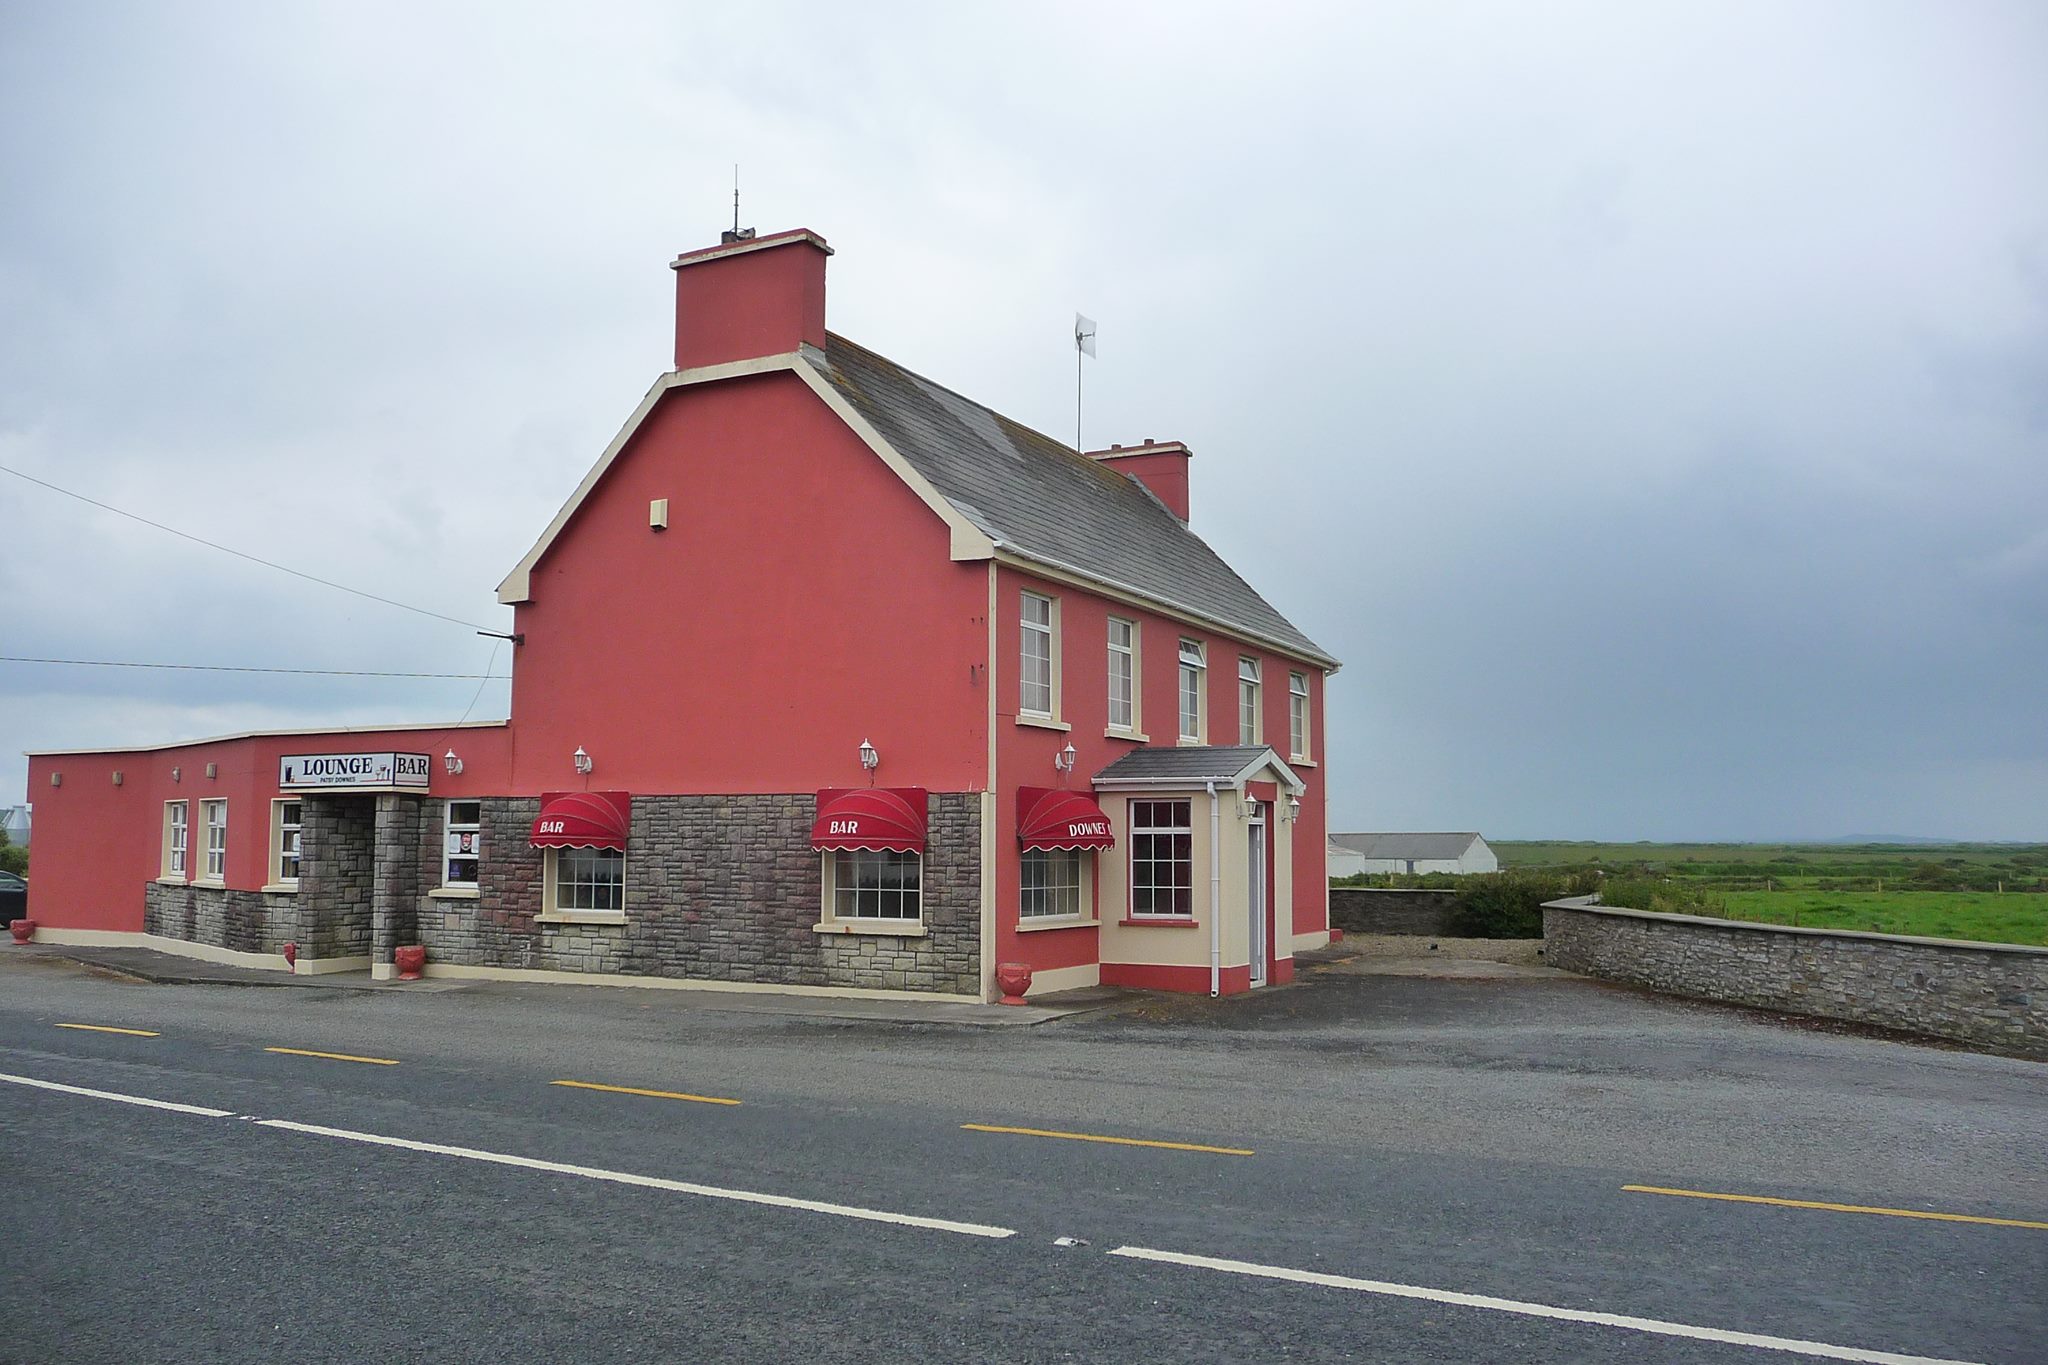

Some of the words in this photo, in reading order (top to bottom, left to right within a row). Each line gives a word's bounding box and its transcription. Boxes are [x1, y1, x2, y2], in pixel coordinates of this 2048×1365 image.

[303, 757, 373, 776] LOUNGE
[397, 757, 428, 775] BAR
[540, 821, 564, 833] BAR
[830, 821, 858, 834] BAR
